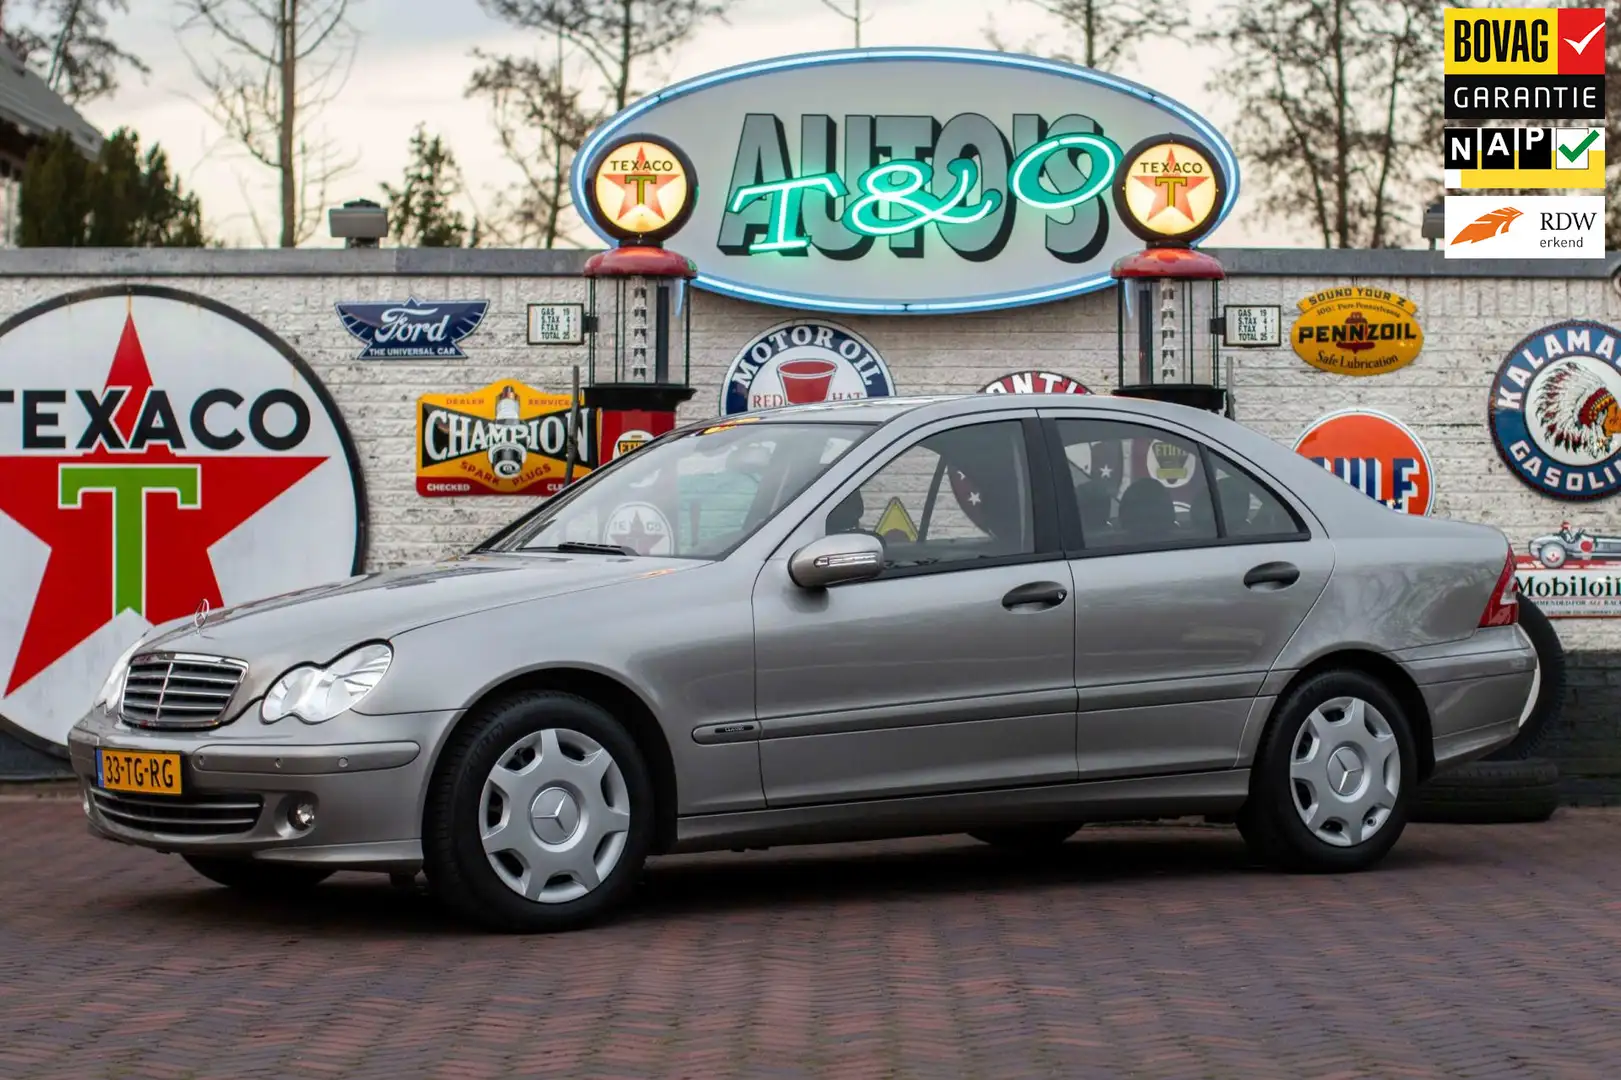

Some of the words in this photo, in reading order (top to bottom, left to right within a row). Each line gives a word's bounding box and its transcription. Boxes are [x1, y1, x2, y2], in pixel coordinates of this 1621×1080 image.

[610, 160, 673, 172] TEXACO
[1141, 162, 1203, 174] TEXACO
[624, 175, 657, 205] T
[717, 113, 1109, 263] AUTO'S
[1155, 176, 1187, 207] T
[1308, 287, 1352, 305] SOUND
[1356, 288, 1391, 300] YOUR
[374, 307, 451, 343] Ford
[1298, 323, 1417, 343] PENNZOIL
[369, 348, 385, 356] THE
[387, 348, 434, 356] UNIVERSAL
[437, 347, 456, 355] CAR
[732, 326, 835, 389] MOTOR
[839, 340, 881, 386] OIL
[1316, 349, 1339, 365] Safe
[1340, 354, 1399, 369] Lubrication
[1497, 329, 1621, 410] KALAMA
[752, 394, 784, 408] RED
[424, 407, 589, 461] CHAMPION
[460, 461, 500, 486] SPARK
[511, 462, 551, 487] PLUGS
[427, 482, 471, 491] CHECKED
[1515, 575, 1621, 597] Mobiloil
[106, 756, 174, 788] 33-TG-RG
